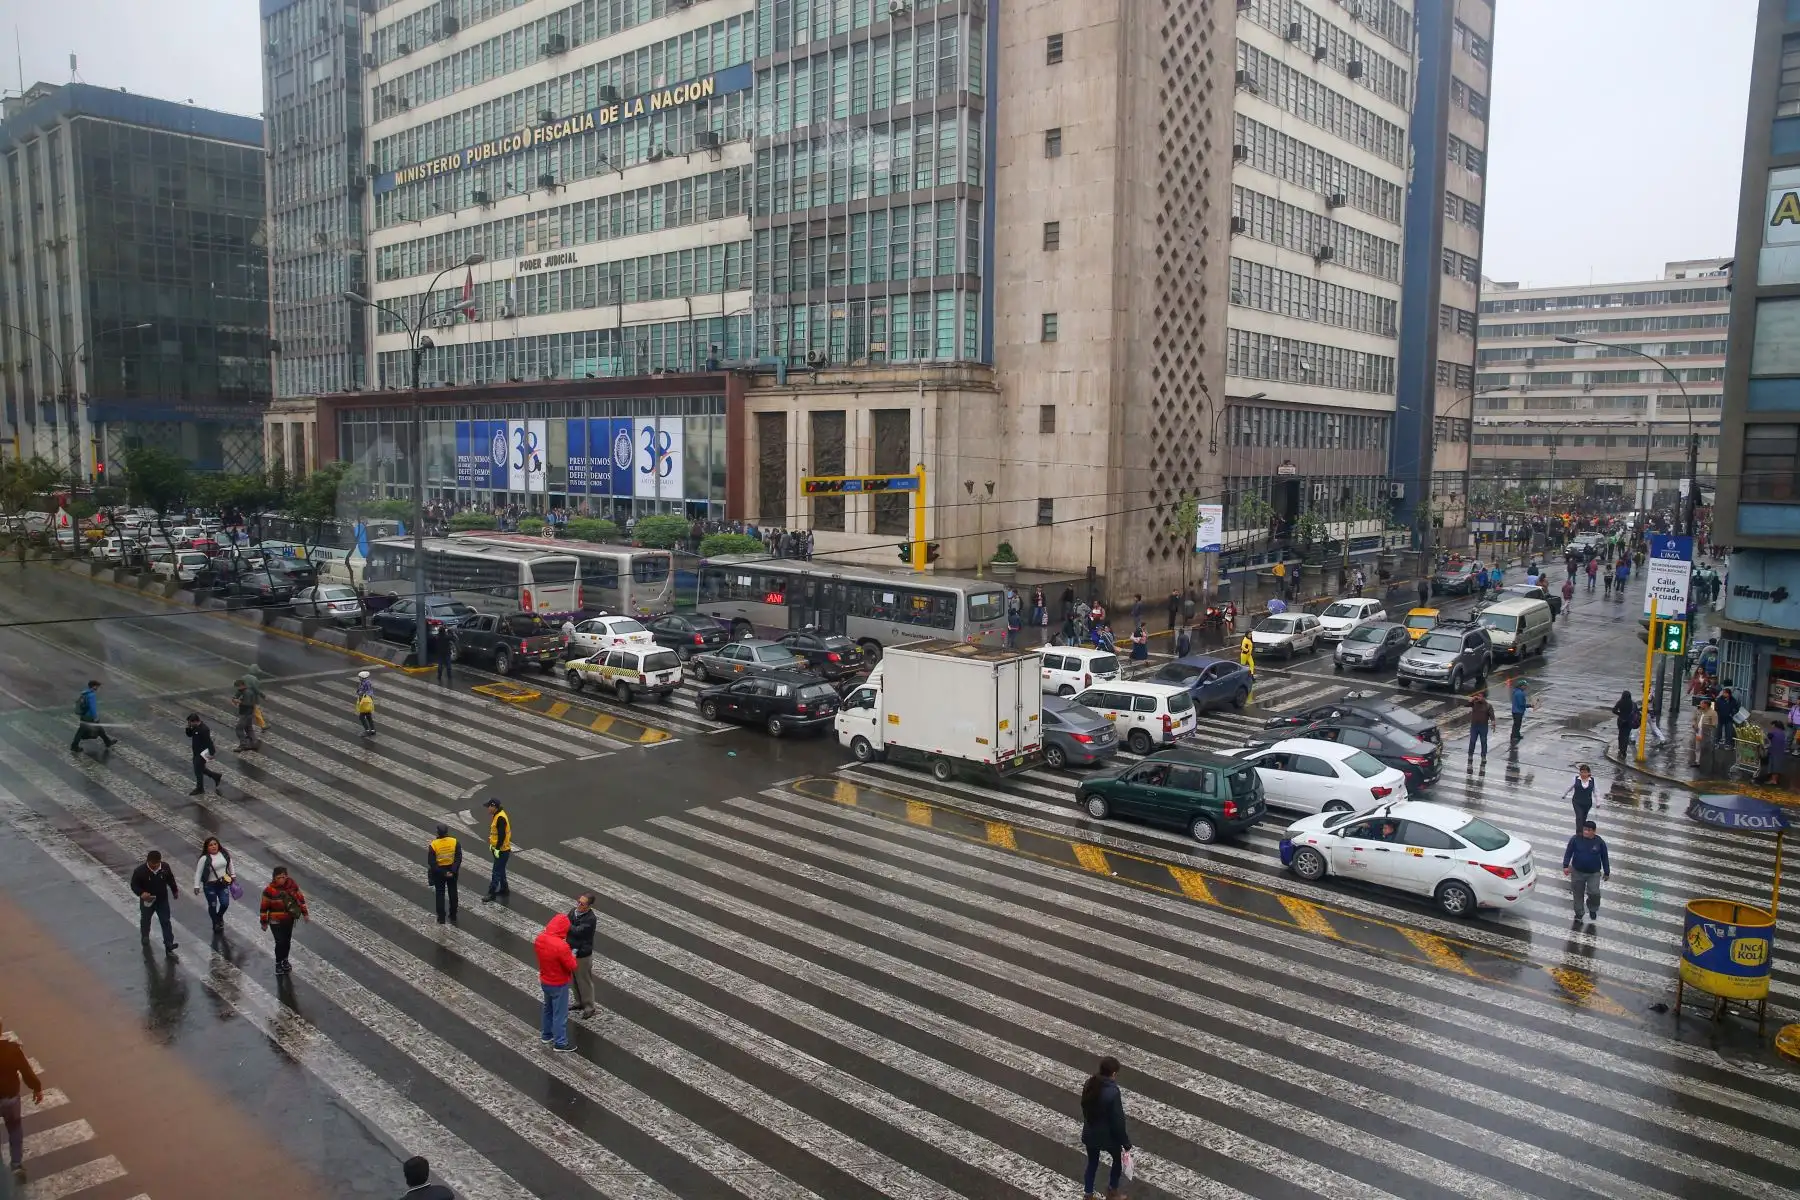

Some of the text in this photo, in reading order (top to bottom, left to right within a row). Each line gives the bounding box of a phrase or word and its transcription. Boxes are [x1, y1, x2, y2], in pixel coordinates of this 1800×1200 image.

[395, 154, 461, 186] MINISTERIO
[600, 105, 619, 124] DE
[624, 98, 645, 119] LA
[520, 252, 578, 272] PODER JUDICIAL
[641, 426, 673, 478] 38
[569, 457, 611, 466] PREVNIMOS
[1660, 551, 1680, 560] LIMA
[1657, 577, 1676, 586] Calle
[1652, 585, 1680, 594] cerrada
[1658, 593, 1684, 602] cuadra
[1668, 626, 1680, 635] 30
[1691, 804, 1783, 828] INCA KOLA
[1740, 943, 1763, 952] INCA
[1737, 951, 1763, 960] KOLA
